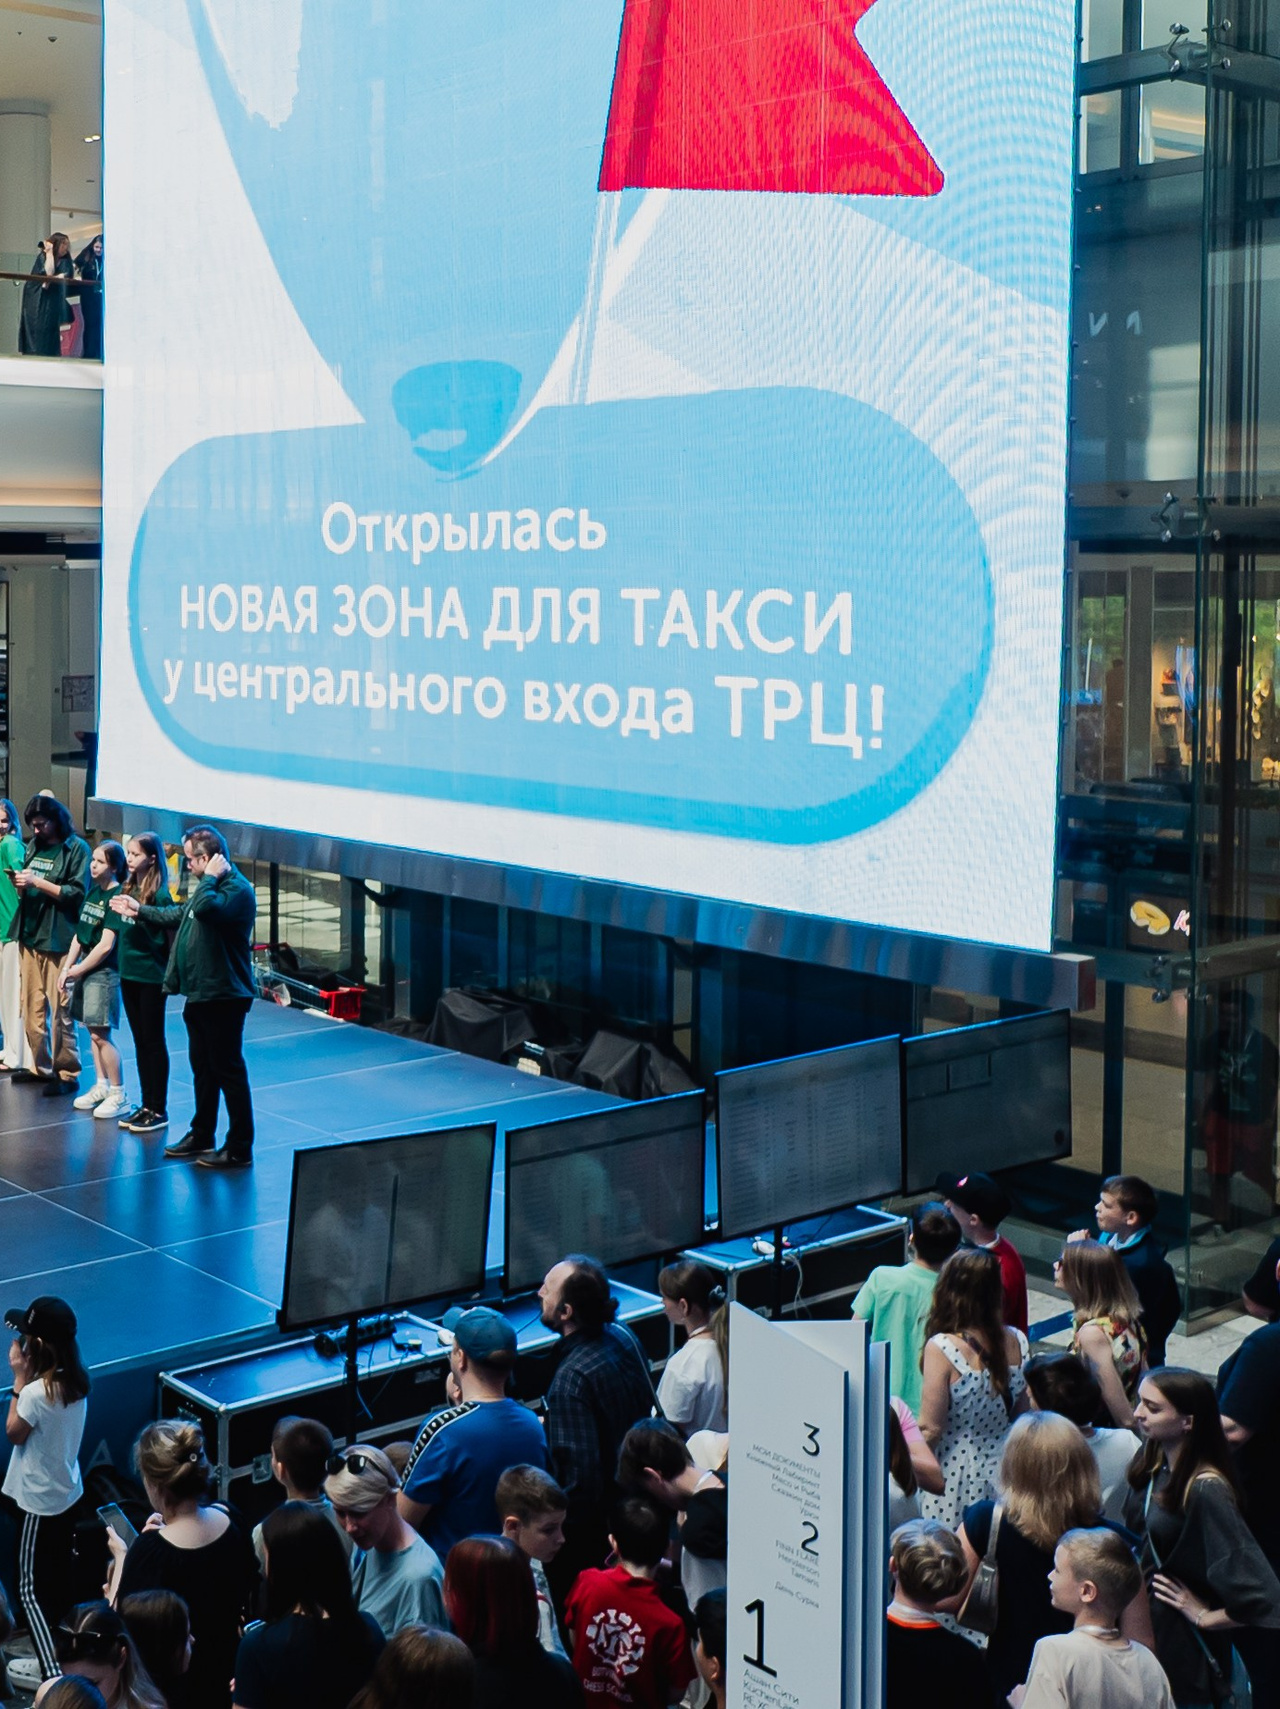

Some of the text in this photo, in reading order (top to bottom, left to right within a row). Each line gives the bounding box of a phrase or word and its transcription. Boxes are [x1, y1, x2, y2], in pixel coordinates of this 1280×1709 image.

[321, 501, 607, 564] Открылась
[180, 583, 853, 655] НОВАЯ ЗОНА ДЛЯ ТАКСИ
[163, 657, 886, 760] у центрального входа ТРЦ!
[802, 1421, 821, 1457] 3
[801, 1520, 820, 1556] 2
[743, 1598, 778, 1679] 1
[744, 1668, 800, 1706] Ашан Сити
